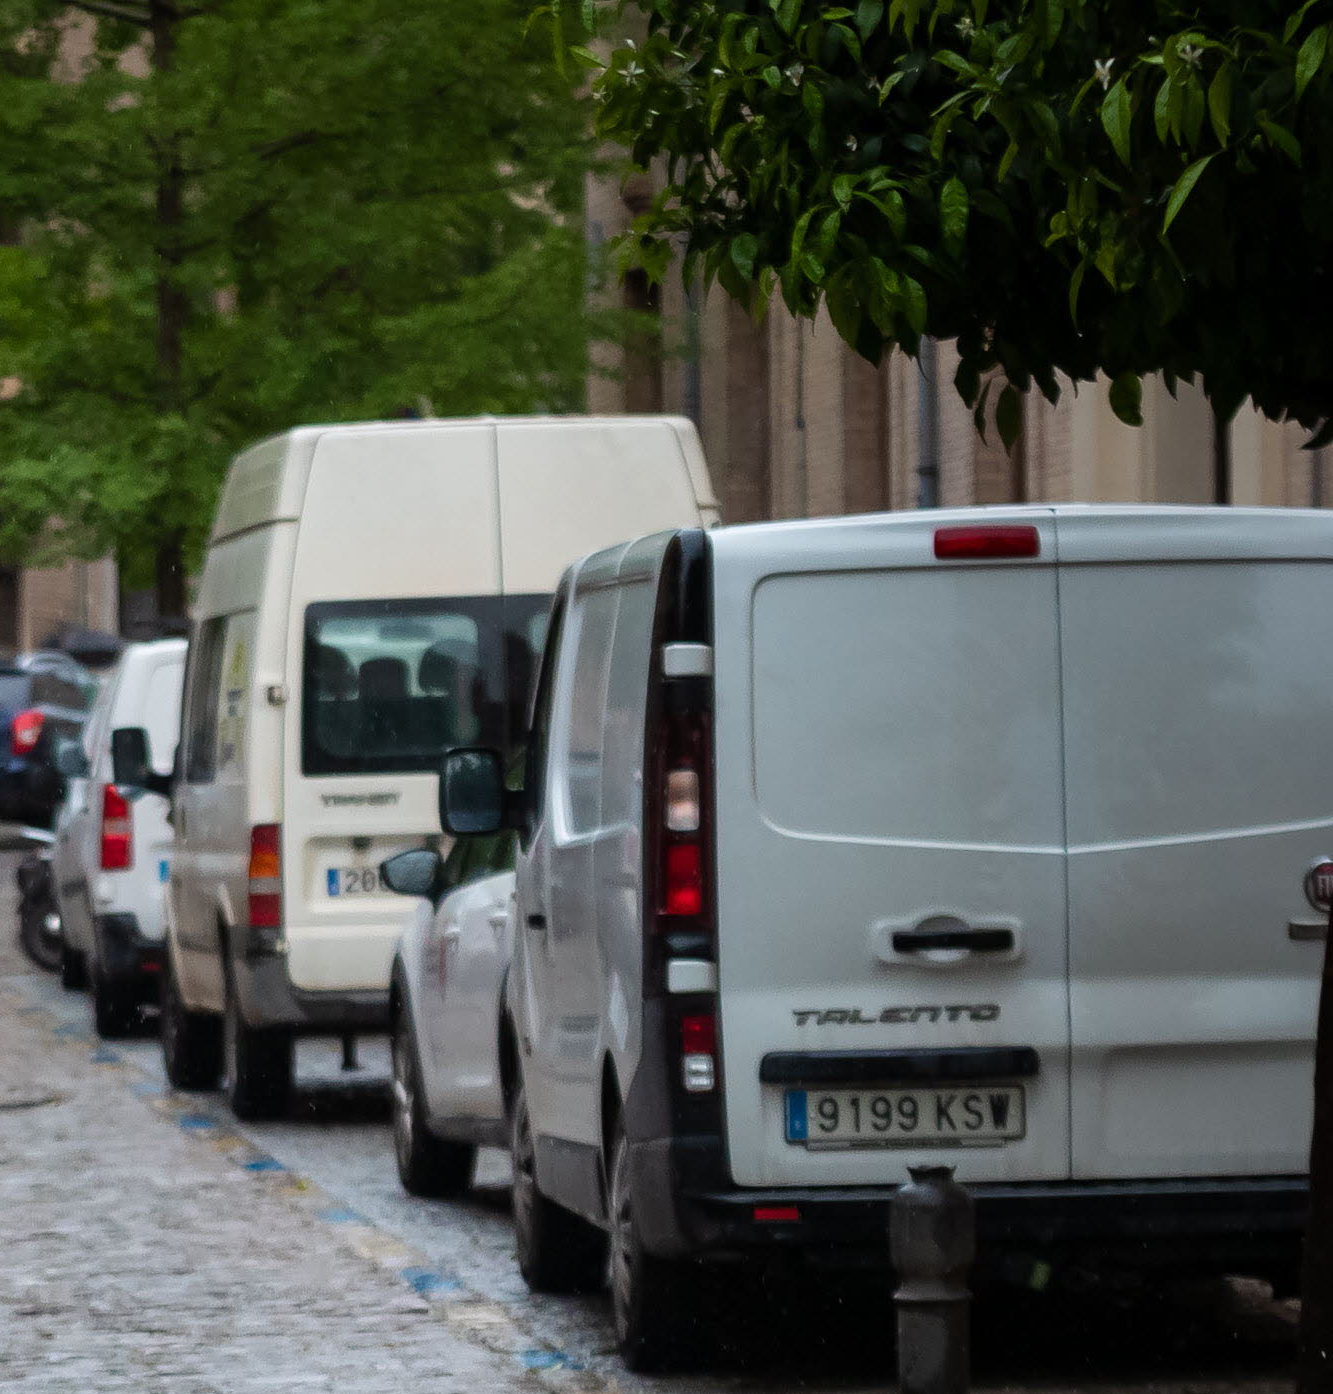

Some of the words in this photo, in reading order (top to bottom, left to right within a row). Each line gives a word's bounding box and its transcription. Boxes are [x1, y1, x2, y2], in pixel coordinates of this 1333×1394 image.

[345, 867, 386, 893] 20
[792, 1003, 1001, 1027] TALENTO
[818, 1094, 920, 1133] 9199
[935, 1093, 1010, 1132] KSW
